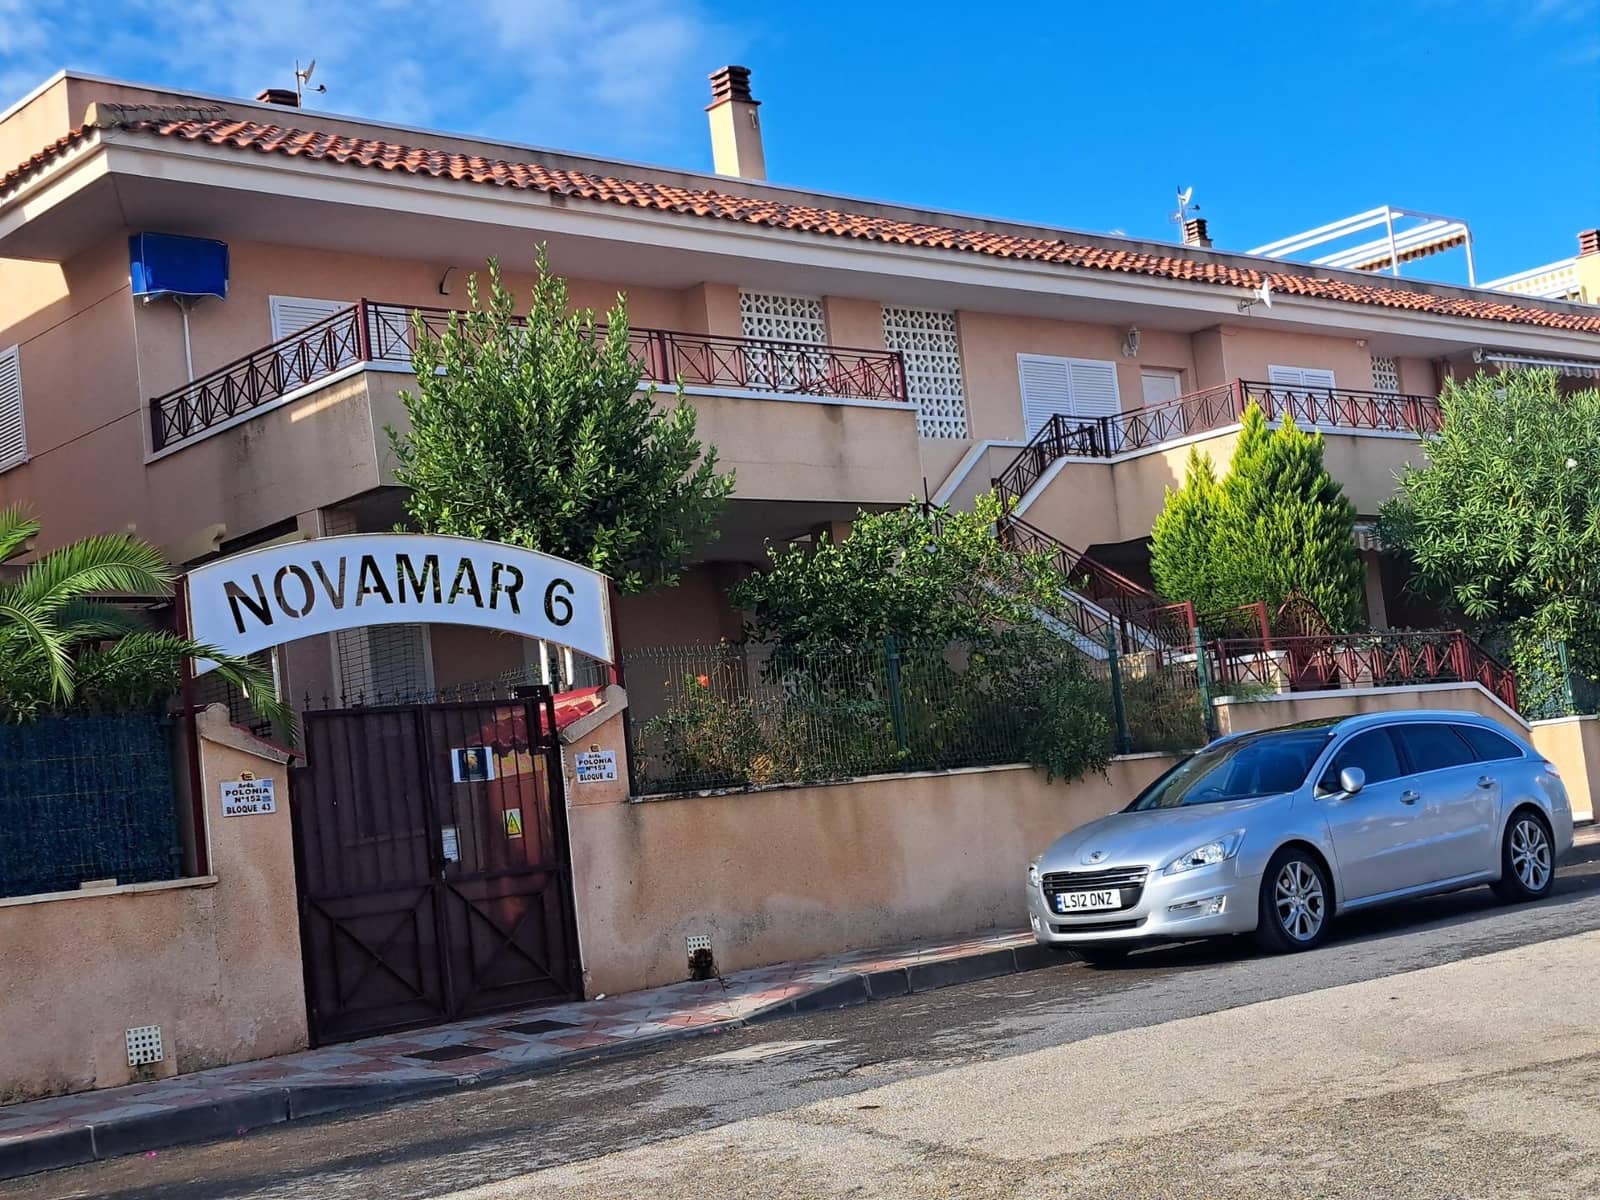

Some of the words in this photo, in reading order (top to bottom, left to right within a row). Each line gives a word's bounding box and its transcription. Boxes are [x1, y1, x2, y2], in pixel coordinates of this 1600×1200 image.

[224, 553, 524, 634] NOVAMAR
[543, 577, 575, 627] 6
[578, 758, 613, 766] POLONIA
[579, 772, 603, 781] BLOQUE
[225, 788, 270, 797] POLONIA
[226, 804, 258, 815] BLOQUE
[262, 803, 271, 811] 43
[1063, 894, 1087, 909] LS12
[1090, 892, 1112, 906] ONZ
